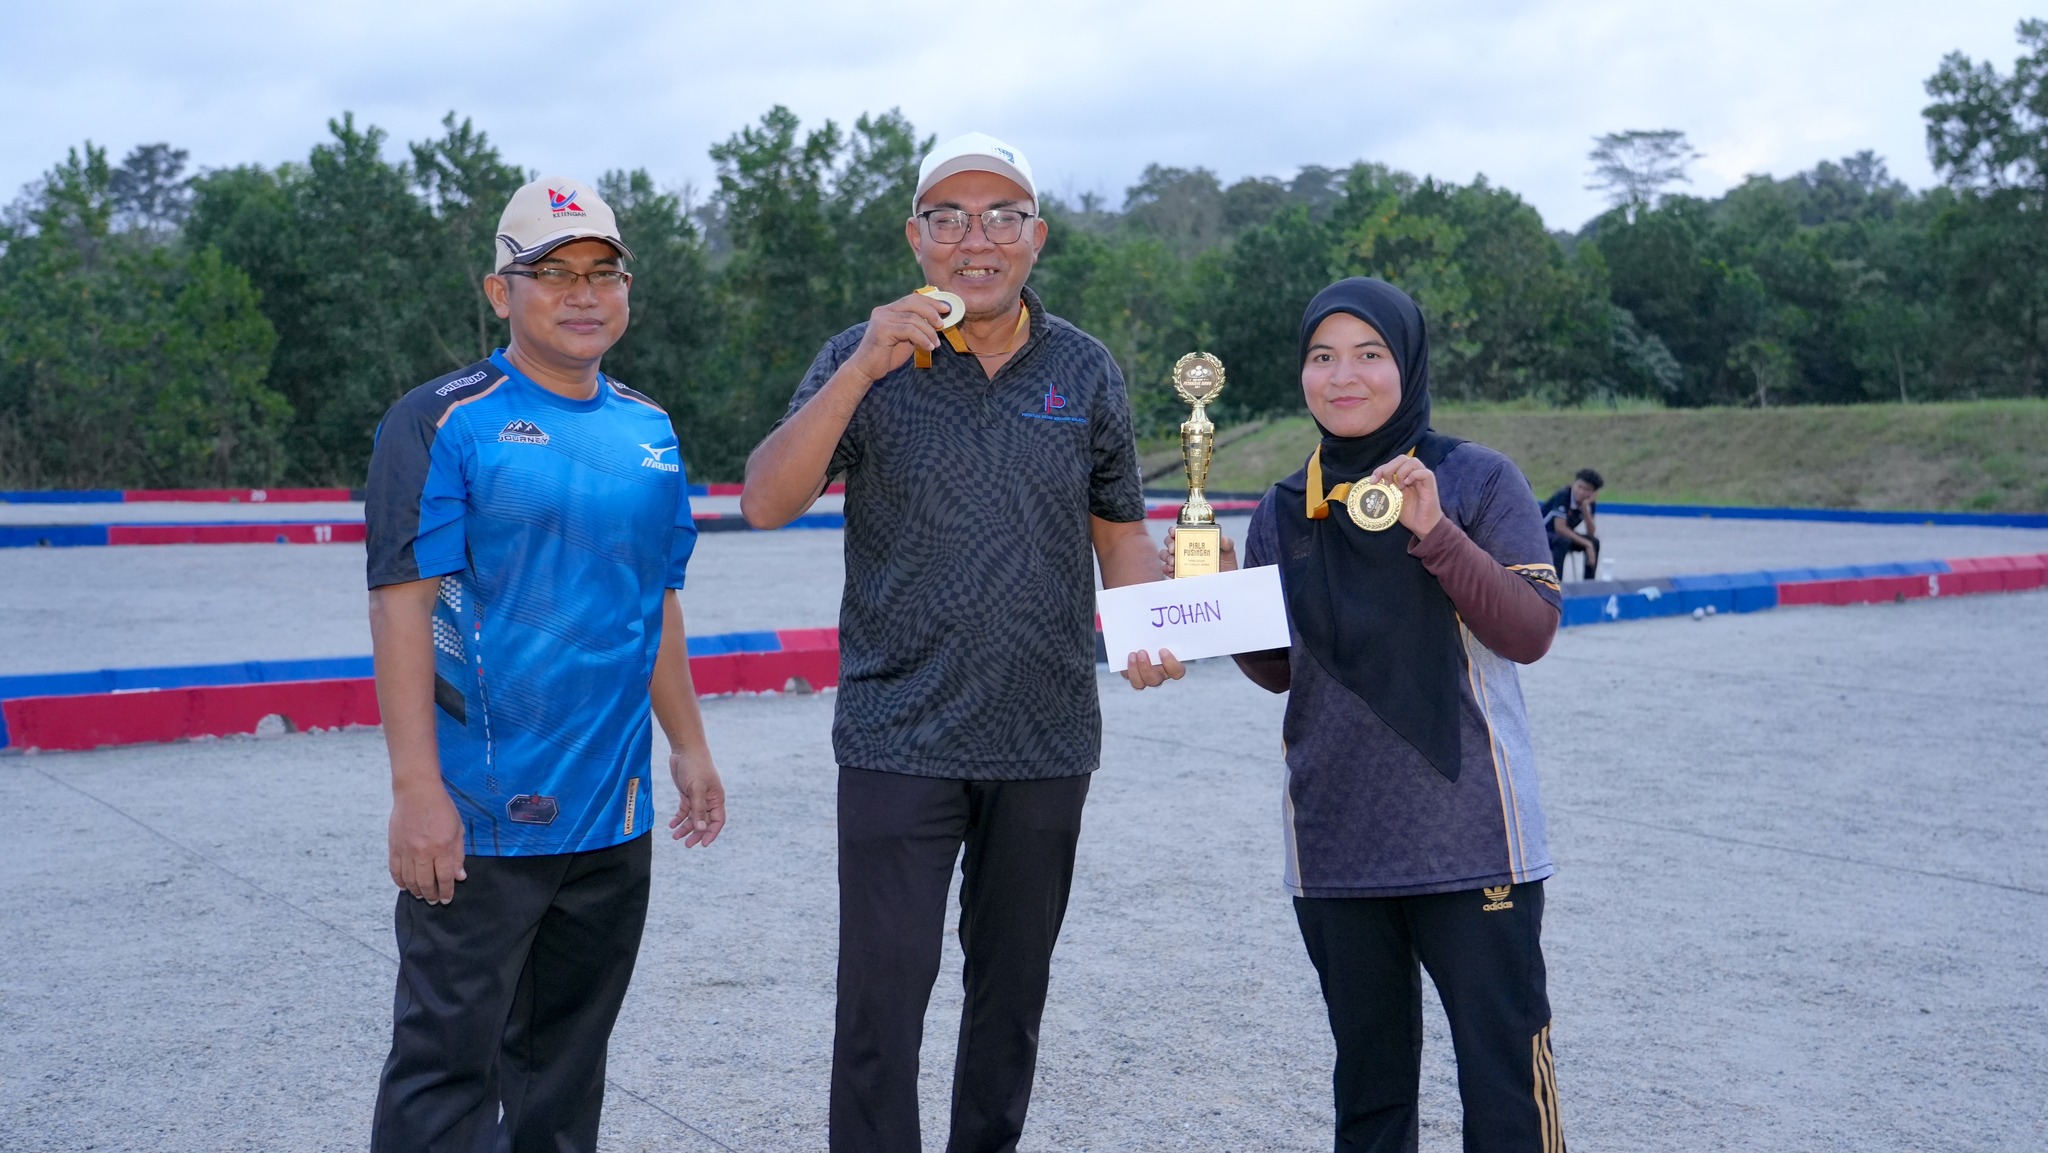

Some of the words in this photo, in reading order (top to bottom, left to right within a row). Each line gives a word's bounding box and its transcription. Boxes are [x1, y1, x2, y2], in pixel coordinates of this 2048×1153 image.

[436, 371, 487, 396] PREMIUM
[499, 435, 548, 445] JOURNEY
[313, 525, 332, 543] 11
[1928, 574, 1940, 598] 5
[1150, 599, 1222, 628] JOHAN
[1605, 595, 1619, 619] 4
[1482, 901, 1514, 912] adidas
